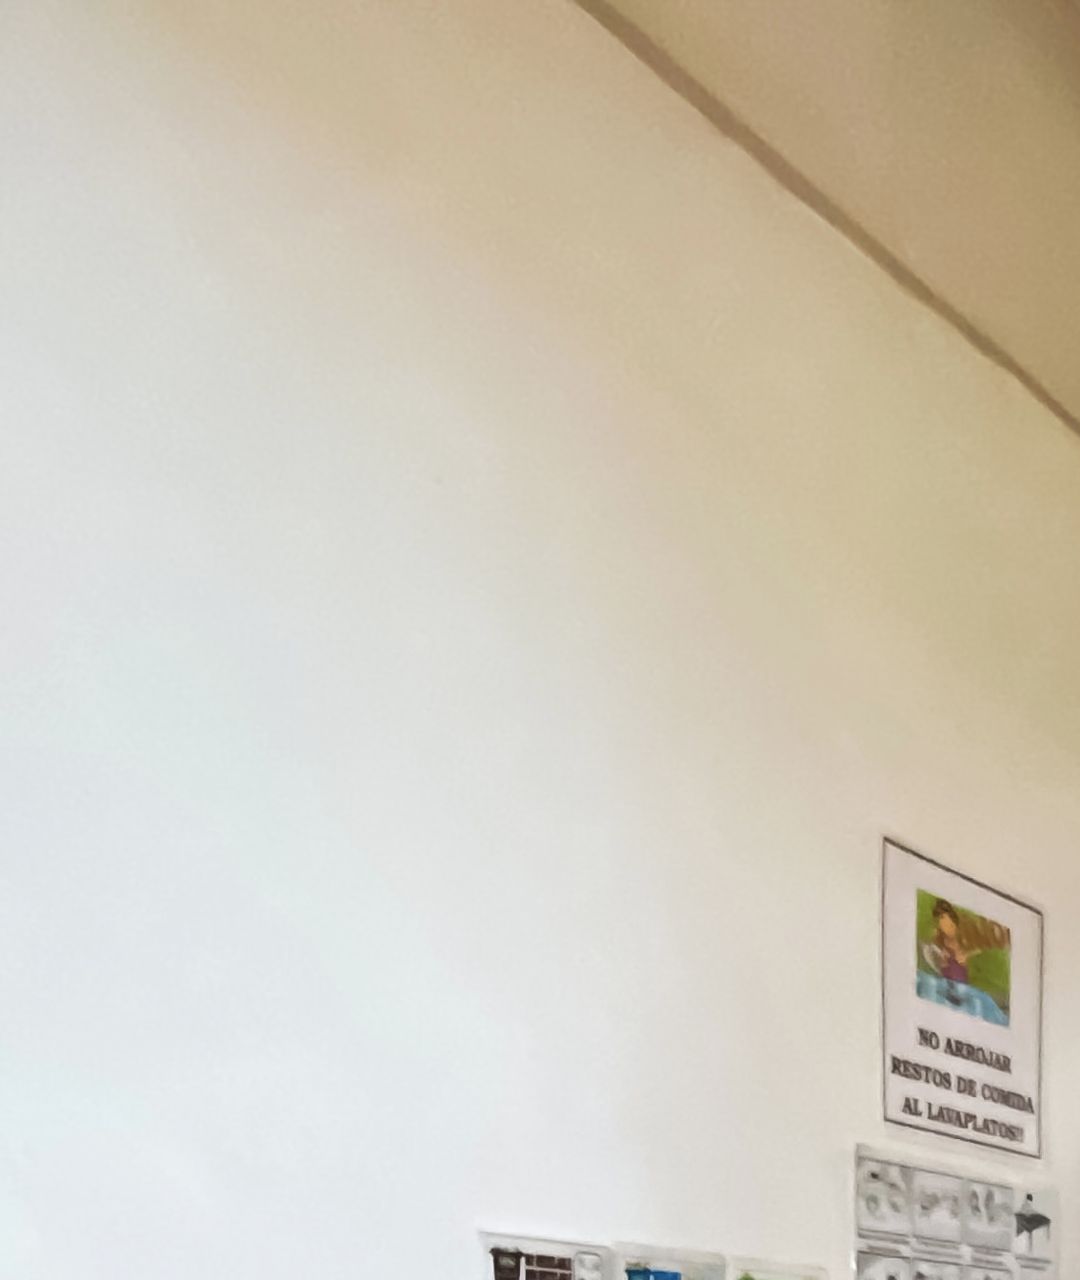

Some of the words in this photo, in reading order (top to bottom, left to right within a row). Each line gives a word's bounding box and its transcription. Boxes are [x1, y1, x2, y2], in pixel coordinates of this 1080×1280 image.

[917, 1027, 940, 1050] NO
[944, 1038, 1012, 1074] ARROJAR
[890, 1055, 952, 1091] RESTOS
[956, 1075, 977, 1098] DE
[902, 1096, 923, 1117] AL
